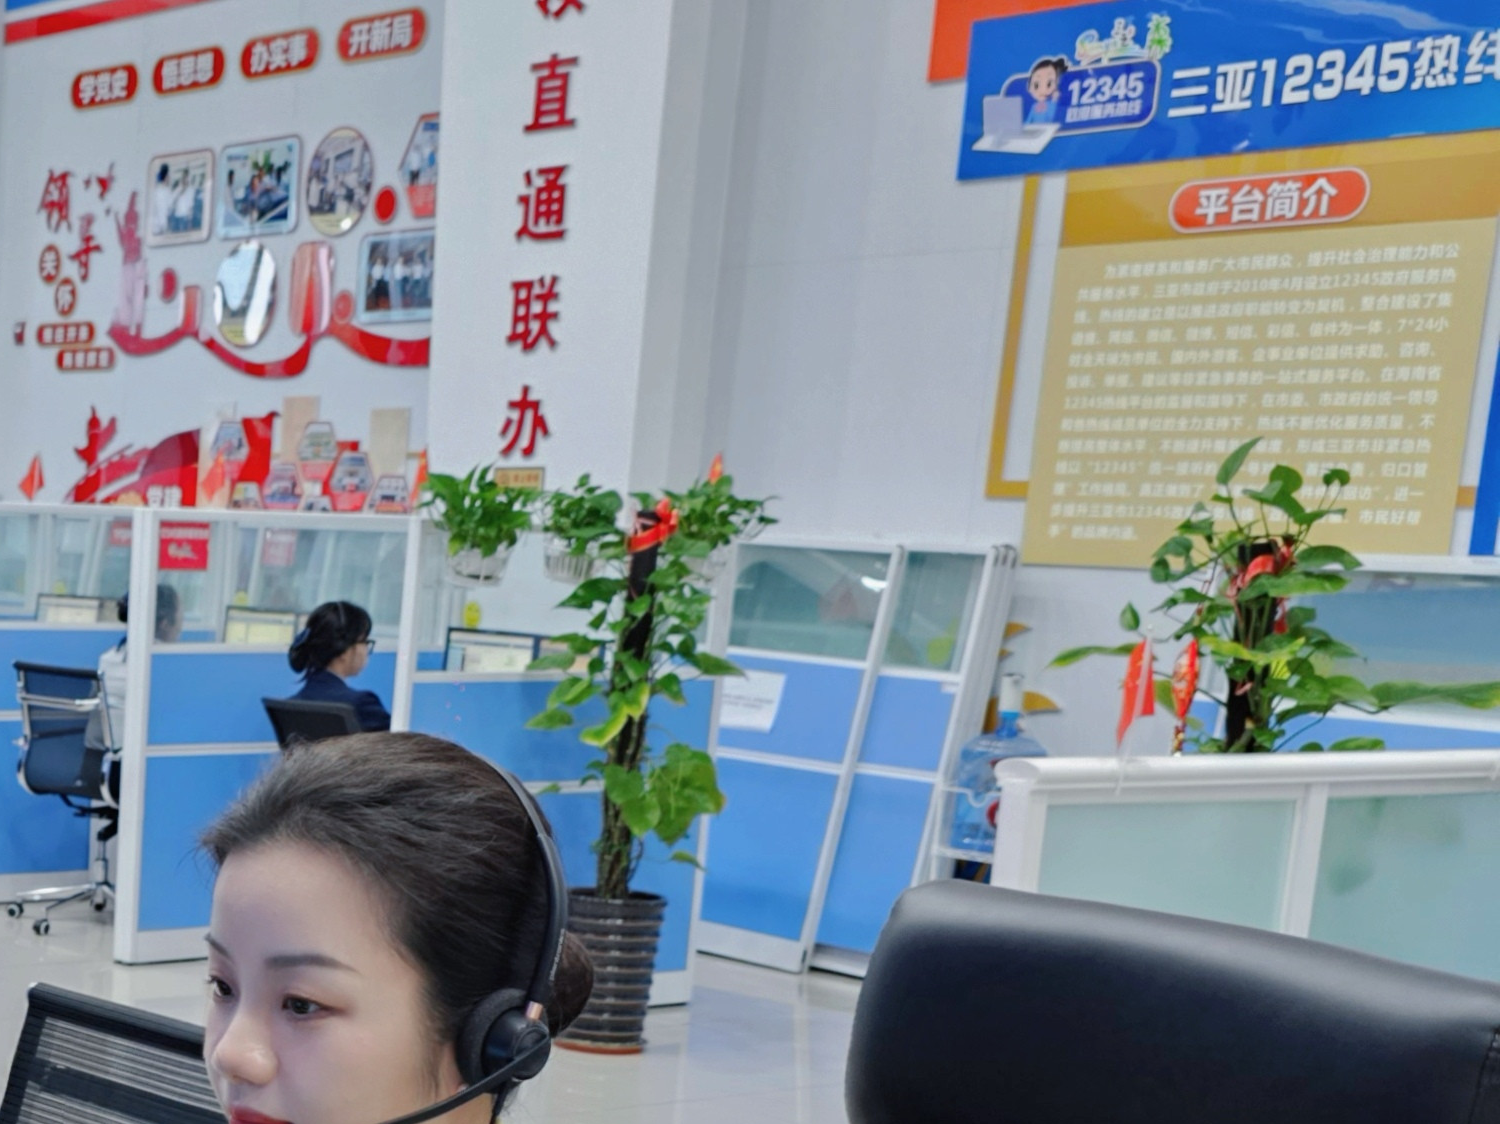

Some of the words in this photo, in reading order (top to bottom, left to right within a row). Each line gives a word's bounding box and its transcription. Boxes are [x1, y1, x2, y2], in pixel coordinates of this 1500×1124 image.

[250, 33, 308, 74] 办实事
[348, 13, 414, 58] 开新局
[77, 67, 129, 105] 学党史
[160, 51, 215, 90] 悟思想
[1067, 71, 1145, 106] 12345
[1195, 177, 1339, 226] 平台简介
[500, 0, 584, 458] 直通联办
